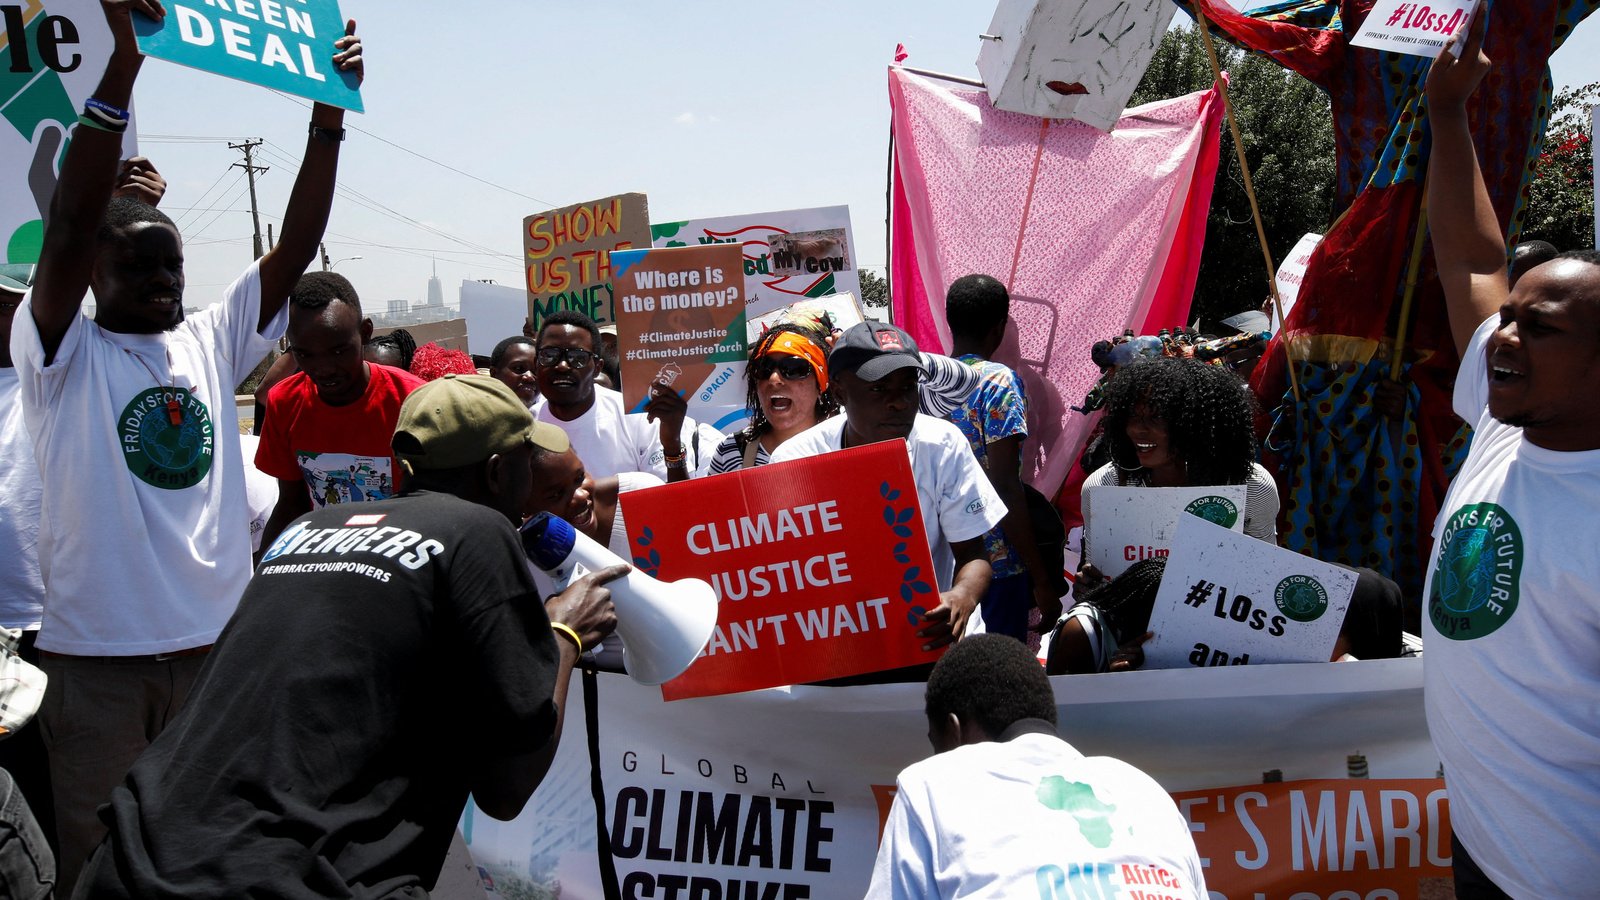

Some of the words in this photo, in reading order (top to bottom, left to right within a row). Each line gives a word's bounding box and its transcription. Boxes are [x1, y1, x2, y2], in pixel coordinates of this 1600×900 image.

[174, 4, 326, 82] DEAL
[528, 199, 622, 259] SHOW
[528, 256, 571, 294] US
[571, 241, 632, 285] TH
[634, 269, 701, 290] Where
[705, 266, 724, 284] is
[622, 295, 655, 313] the
[660, 286, 738, 310] money?
[626, 341, 743, 361] #ClimateJusticeTorch
[639, 327, 728, 344] #ClimateJustice
[651, 370, 676, 397] PCJA
[700, 367, 735, 403] @PACJA1
[125, 394, 157, 453] FRIDAYS
[154, 392, 185, 406] FOR
[187, 399, 212, 456] FUTURE
[144, 464, 198, 486] Kenya
[1193, 497, 1210, 508] FOR
[1212, 497, 1236, 514] FUTURE
[686, 500, 843, 556] CLIMATE
[262, 561, 392, 583] #EMBRACEYOURPOWERS
[711, 552, 852, 604] JUSTICE
[1487, 532, 1515, 616] FUTURE
[1276, 580, 1290, 609] FRIDAYS
[1290, 576, 1306, 584] FOR
[1307, 579, 1327, 605] FUTURE
[699, 614, 788, 658] AN'T
[793, 597, 889, 641] WAIT
[1430, 592, 1471, 635] Kenya
[622, 751, 826, 795] GLOBAL
[610, 786, 835, 873] CLIMATE
[1035, 862, 1121, 900] ONE
[1121, 864, 1182, 889] Africa
